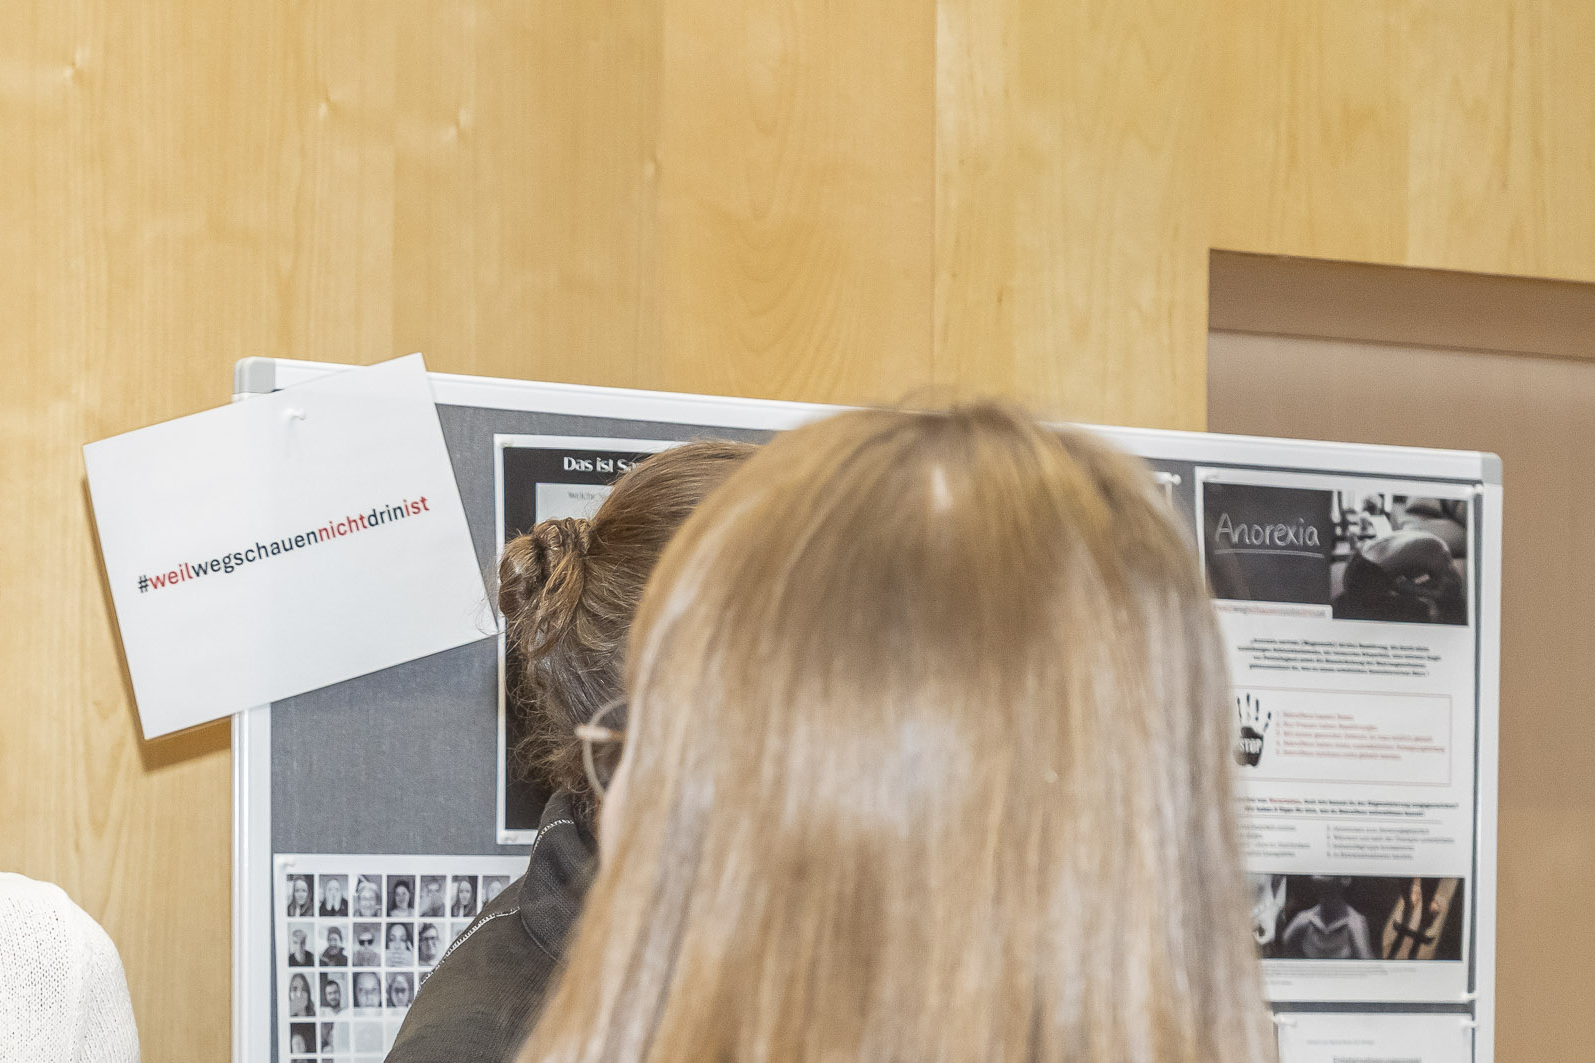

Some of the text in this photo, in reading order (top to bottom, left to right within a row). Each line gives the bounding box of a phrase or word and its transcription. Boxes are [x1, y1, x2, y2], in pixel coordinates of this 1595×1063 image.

[563, 456, 593, 472] Das
[596, 457, 613, 473] ist
[138, 496, 430, 593] #weilwegschauennichtdrinist
[1214, 512, 1320, 548] Anorexia
